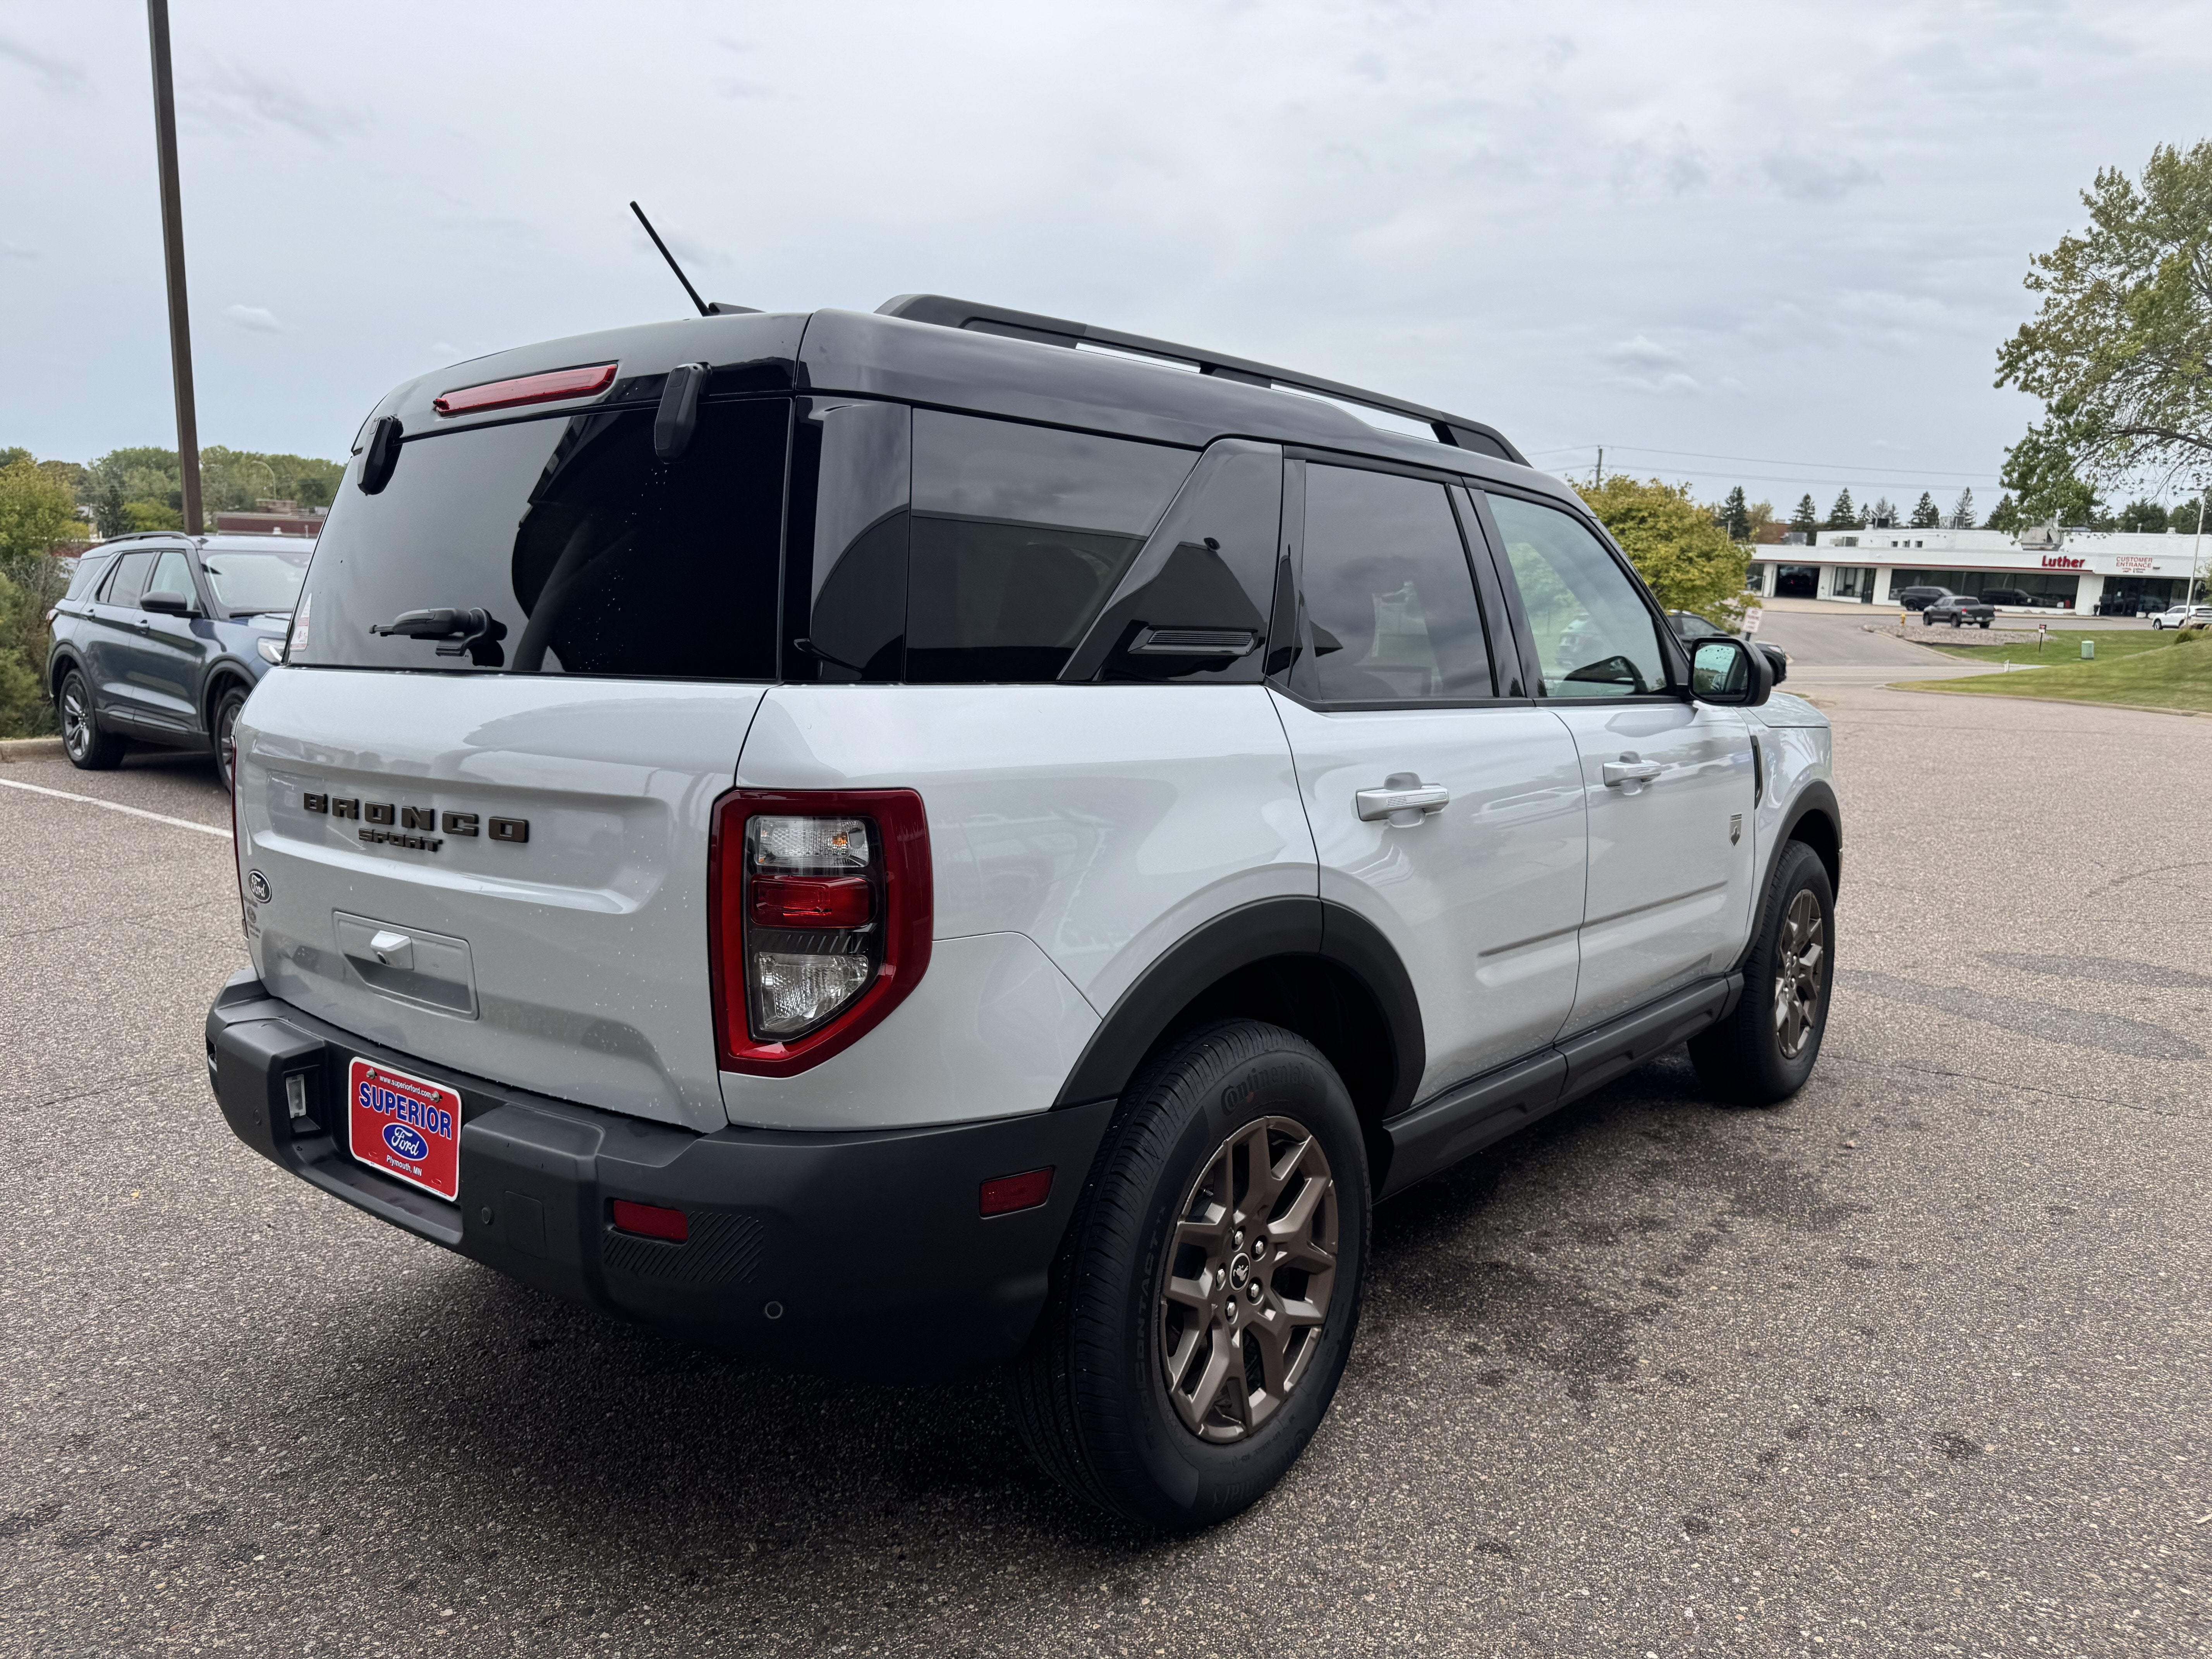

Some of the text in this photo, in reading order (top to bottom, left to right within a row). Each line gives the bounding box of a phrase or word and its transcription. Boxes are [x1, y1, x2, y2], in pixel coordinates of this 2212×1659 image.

[2042, 555, 2085, 568] Luther
[304, 791, 529, 843] BRONCO
[359, 828, 443, 852] SPORT
[380, 1075, 432, 1099] www.superiorford.com
[1221, 1062, 1305, 1116] Continental
[359, 1081, 452, 1140] SUPERIOR
[392, 1127, 420, 1156] Ford
[386, 1154, 422, 1176] Plymouth, MN
[1135, 1231, 1158, 1433] OCONTACT
